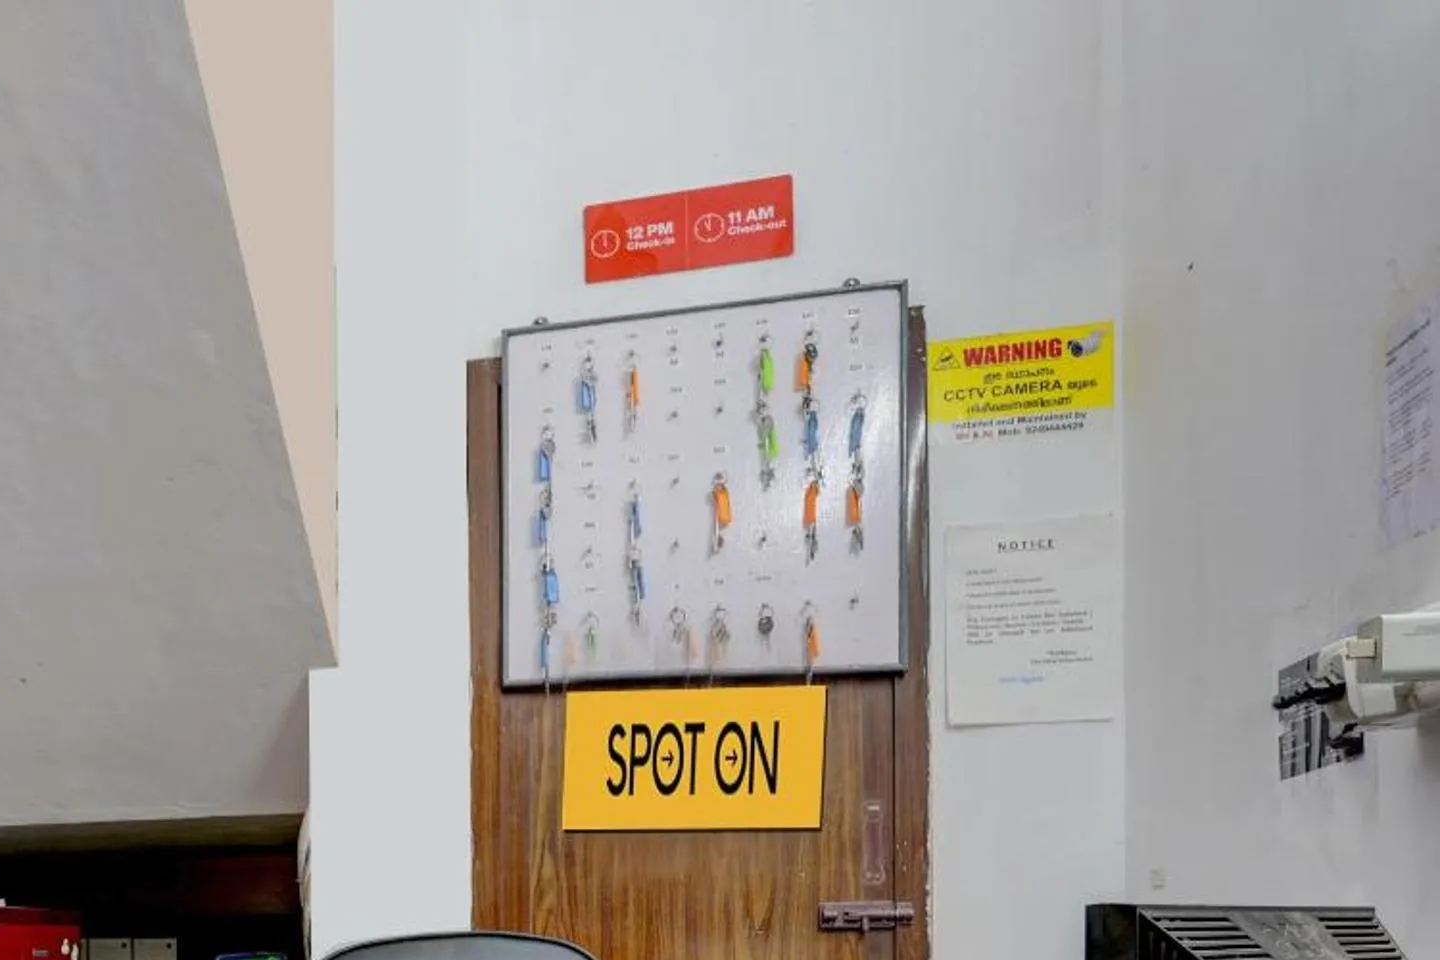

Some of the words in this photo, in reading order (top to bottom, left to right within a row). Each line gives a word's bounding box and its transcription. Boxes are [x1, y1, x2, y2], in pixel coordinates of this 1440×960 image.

[727, 211, 742, 224] 11
[745, 206, 775, 222] AM
[626, 226, 644, 240] 12
[646, 221, 674, 236] PM
[727, 219, 788, 236] Check-out
[626, 236, 676, 251] Check-in
[963, 338, 1063, 368] WARNING
[944, 386, 987, 402] CCTV
[991, 379, 1063, 398] CAMERA
[1075, 410, 1088, 420] by
[998, 538, 1056, 552] NOTICE
[606, 721, 706, 797] SPOT
[714, 720, 781, 795] ON
